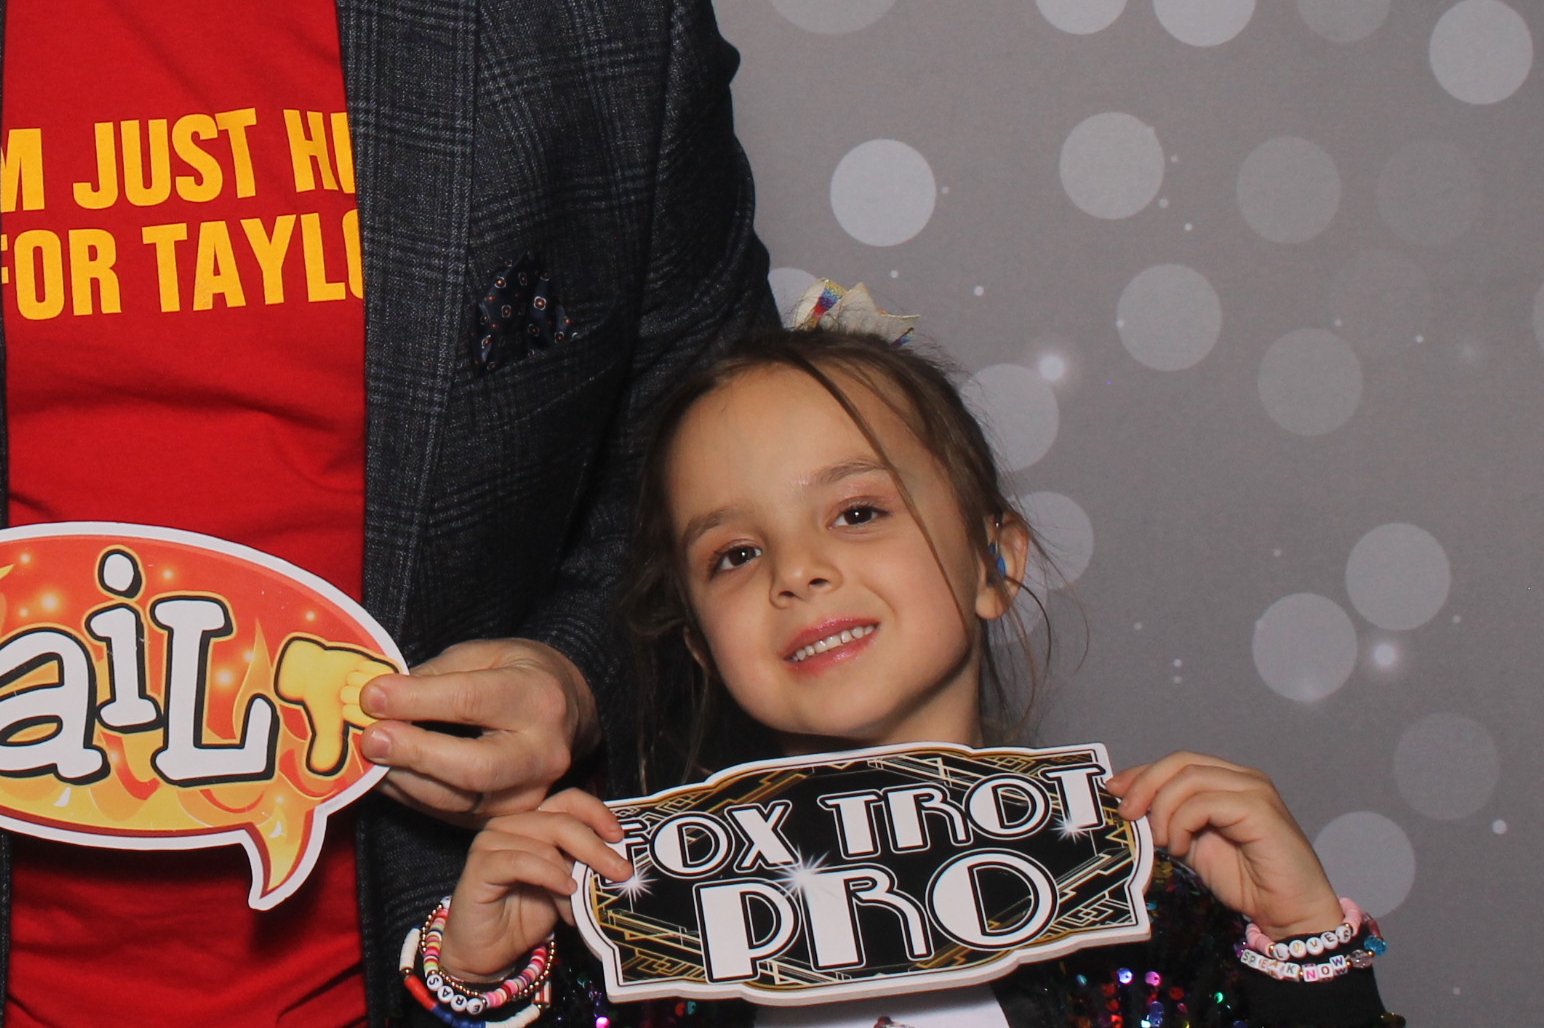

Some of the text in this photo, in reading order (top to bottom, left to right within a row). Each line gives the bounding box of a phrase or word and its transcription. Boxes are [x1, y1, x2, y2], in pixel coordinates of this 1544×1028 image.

[73, 107, 257, 210] JUST
[1, 229, 122, 320] OR
[818, 764, 1107, 859] TROT
[694, 848, 1059, 984] PRO
[1273, 928, 1352, 960] LOVER
[428, 976, 482, 1014] ERAS
[1241, 950, 1346, 980] SPEAK NOW
